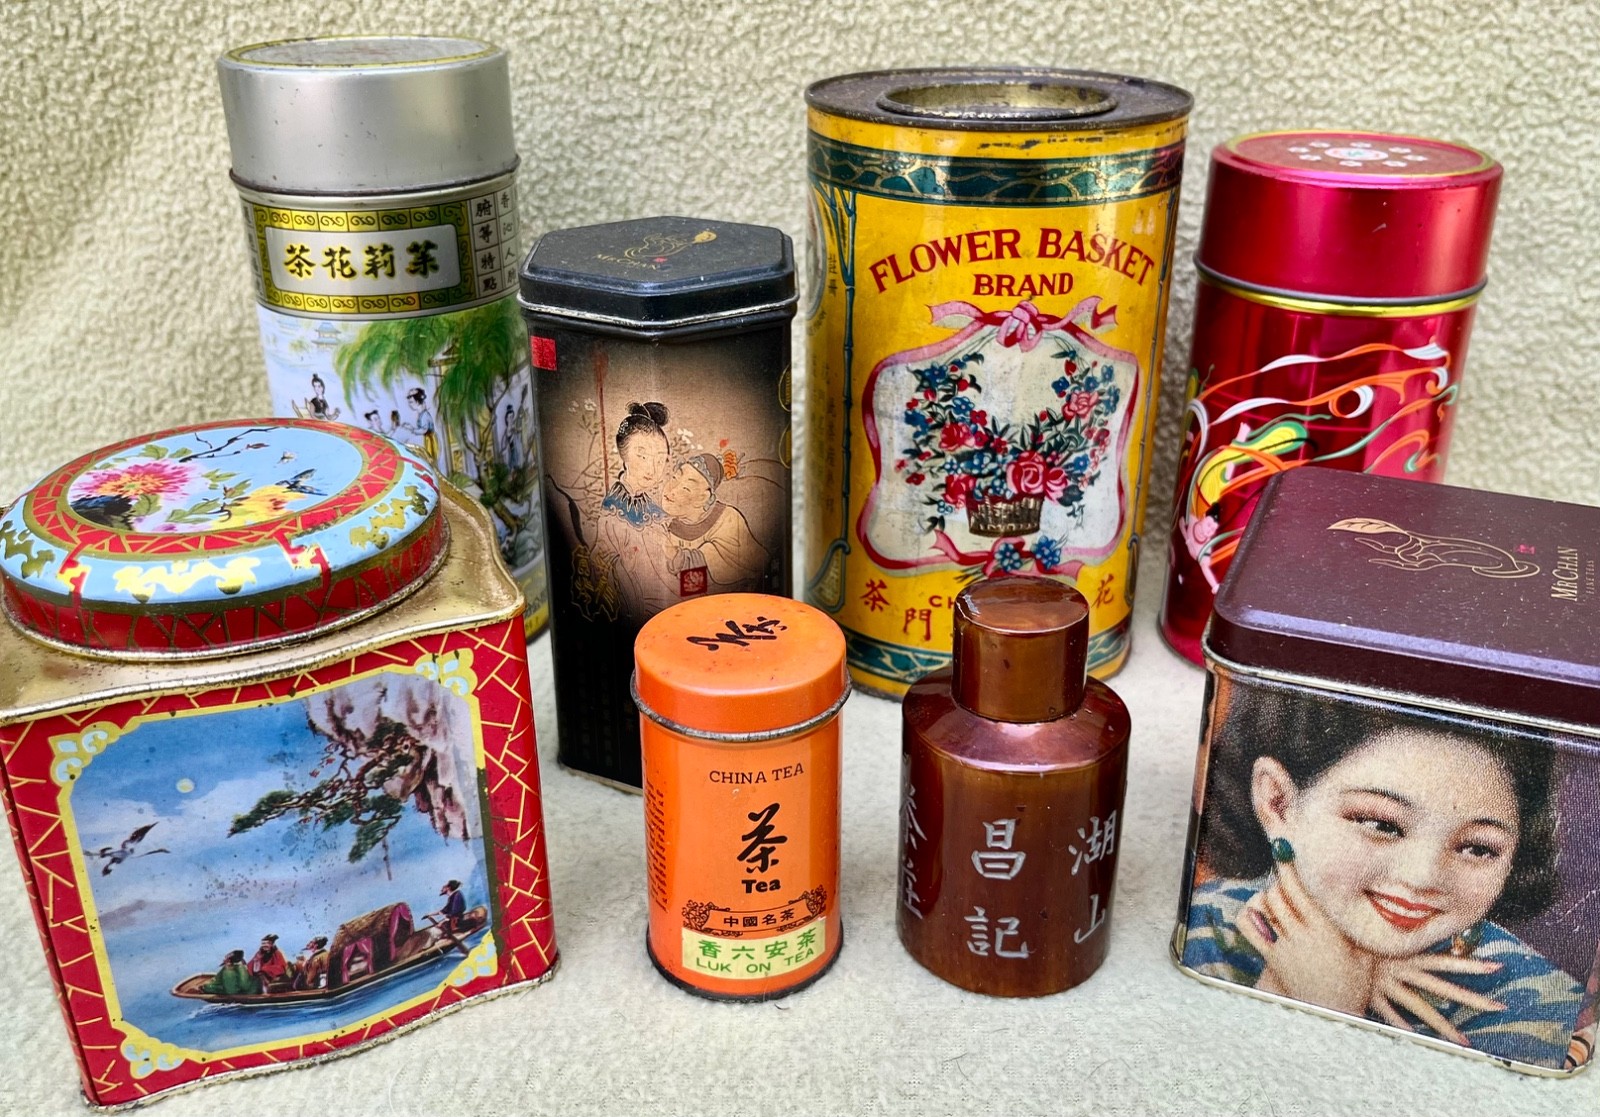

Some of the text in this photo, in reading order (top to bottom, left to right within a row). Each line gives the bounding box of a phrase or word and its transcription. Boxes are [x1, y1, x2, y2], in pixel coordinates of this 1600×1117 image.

[868, 228, 1021, 294] FLOWER
[1036, 228, 1155, 287] BASKET
[972, 272, 1074, 297] BRAND
[860, 579, 890, 612] 茶
[709, 763, 805, 785] CHINA TEA
[737, 802, 788, 874] 茶
[741, 879, 781, 894] Tea
[964, 818, 1030, 960] 昌記
[723, 908, 795, 928] 中國名茶
[699, 927, 817, 960] 香六安茶
[696, 948, 815, 974] LUK ON TEA
